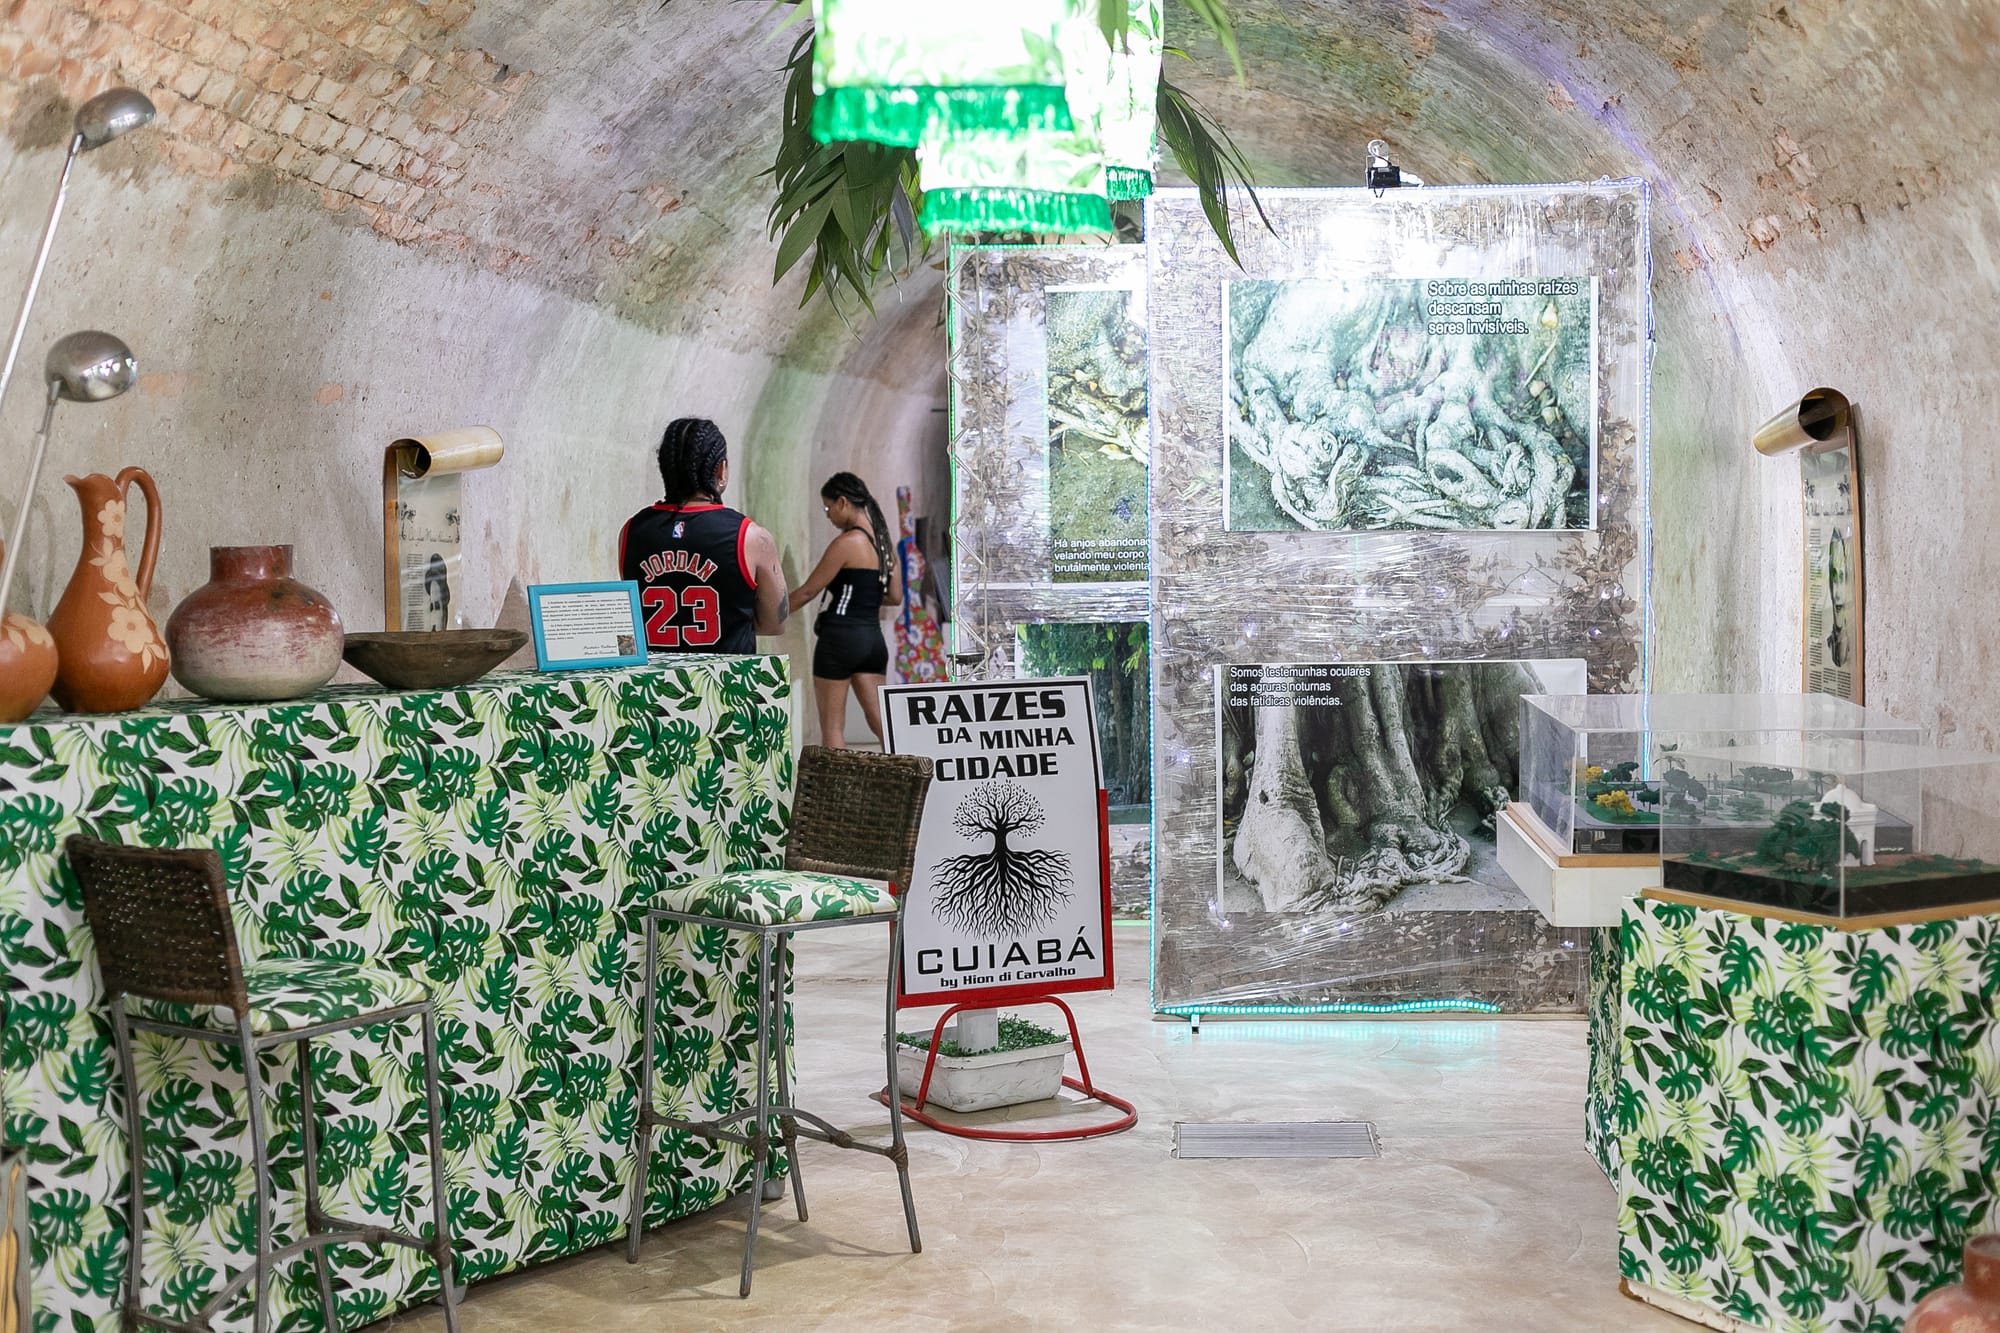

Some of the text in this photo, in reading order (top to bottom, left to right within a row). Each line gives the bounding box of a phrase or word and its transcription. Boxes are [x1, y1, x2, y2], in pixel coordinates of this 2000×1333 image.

[1428, 280, 1578, 296] Sobre as minhas raízes
[1428, 301, 1502, 315] descansam
[1428, 319, 1529, 335] seres invisíveis.
[1054, 539, 1068, 548] Há
[1070, 539, 1096, 549] anjos
[1054, 551, 1091, 560] velando
[1117, 551, 1145, 560] corpo
[640, 550, 718, 582] JORDAN
[1055, 562, 1110, 572] brutalmente
[642, 585, 721, 646] 23
[1230, 666, 1371, 677] Somos testemunhas oculares
[1230, 681, 1331, 694] das agruras noturnas
[907, 689, 1066, 726] RAIZES
[1230, 695, 1343, 707] das fatídicas violências.
[937, 726, 1075, 750] DA MINHA
[935, 752, 1059, 782] CIDADE
[917, 926, 1095, 975] CUIABÁ
[940, 966, 1076, 988] by Hion di Carvalho
